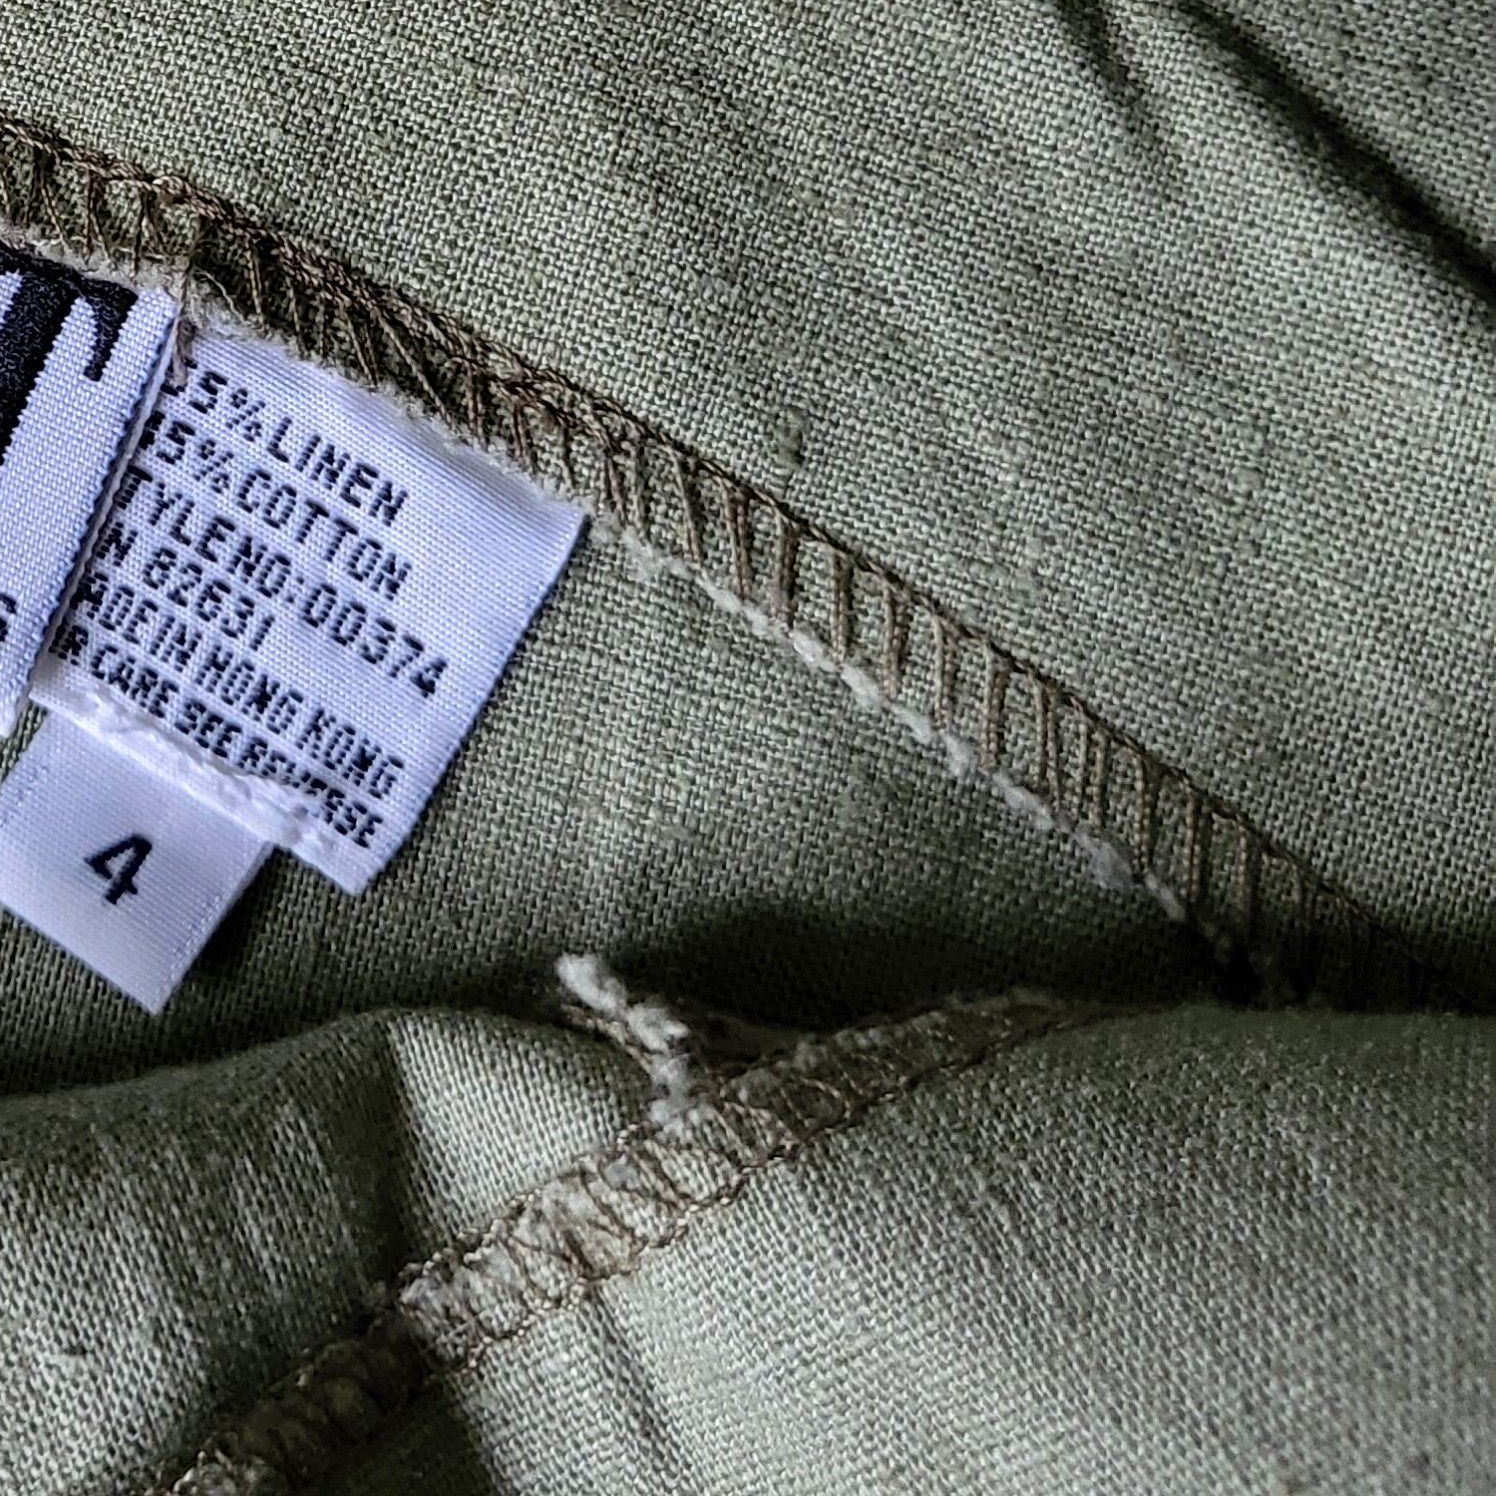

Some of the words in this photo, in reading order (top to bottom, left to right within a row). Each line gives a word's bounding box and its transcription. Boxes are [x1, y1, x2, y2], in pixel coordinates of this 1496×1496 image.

[143, 548, 275, 651] 82631
[91, 644, 180, 718] CARE
[174, 699, 242, 759] SEE
[195, 645, 304, 735] HONG
[296, 707, 404, 800] KONG
[84, 834, 152, 905] 4
